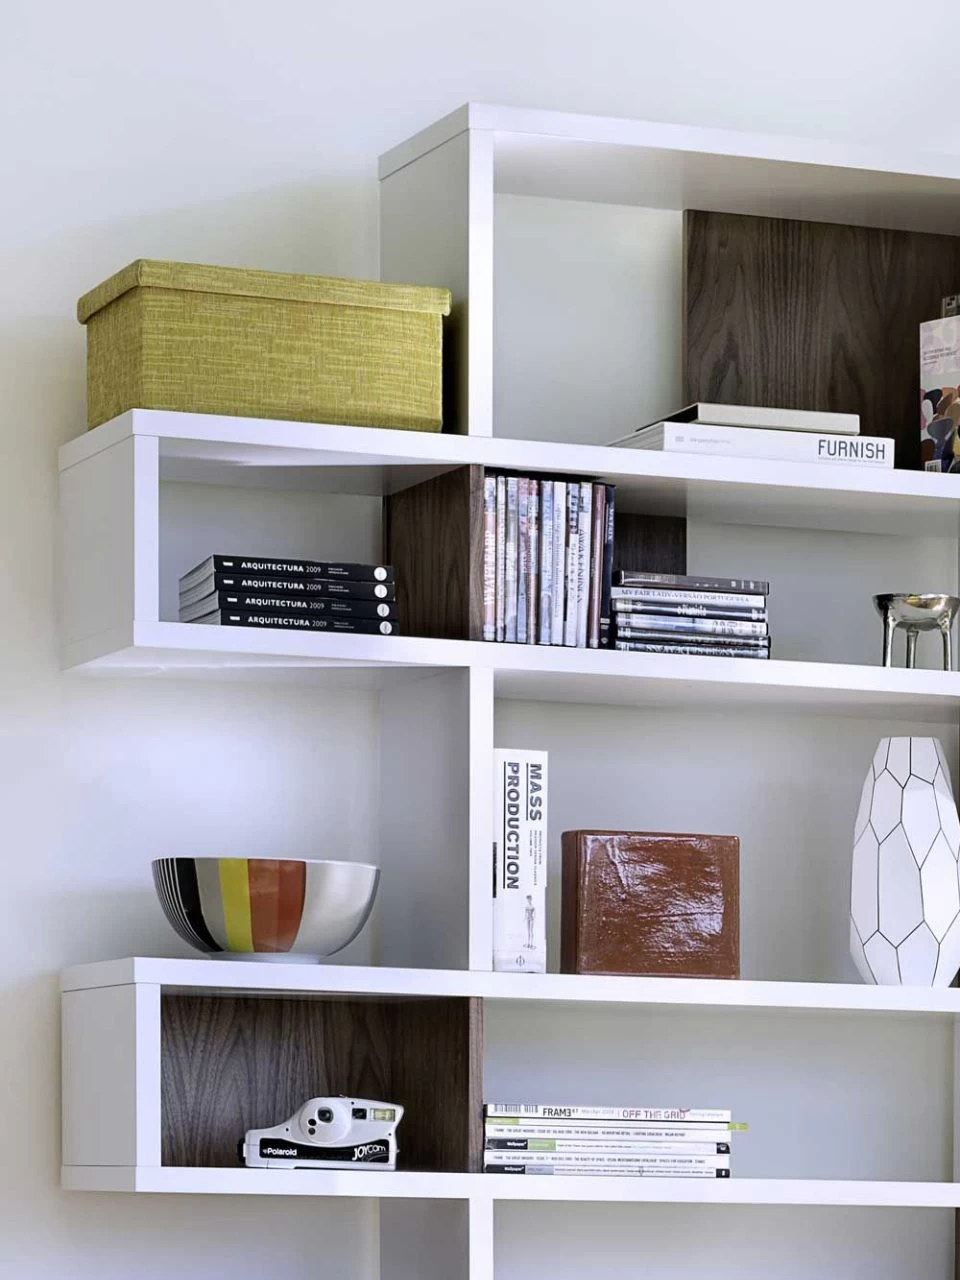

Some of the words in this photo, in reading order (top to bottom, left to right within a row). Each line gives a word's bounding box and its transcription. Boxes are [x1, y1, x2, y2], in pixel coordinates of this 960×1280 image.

[818, 439, 885, 460] FURNISH
[241, 562, 304, 573] ARQUITECTURA
[242, 579, 304, 590] ARQUITECTURA
[245, 597, 307, 608] ARQUITECTURA
[309, 601, 325, 609] 2009
[248, 616, 310, 627] ARQUITECTURA
[529, 763, 543, 821] MASS
[506, 762, 520, 890] PRODUCTION
[622, 1109, 642, 1119] OFF
[644, 1110, 662, 1119] THE
[663, 1109, 687, 1120] GRID
[267, 1147, 297, 1156] Polaroid
